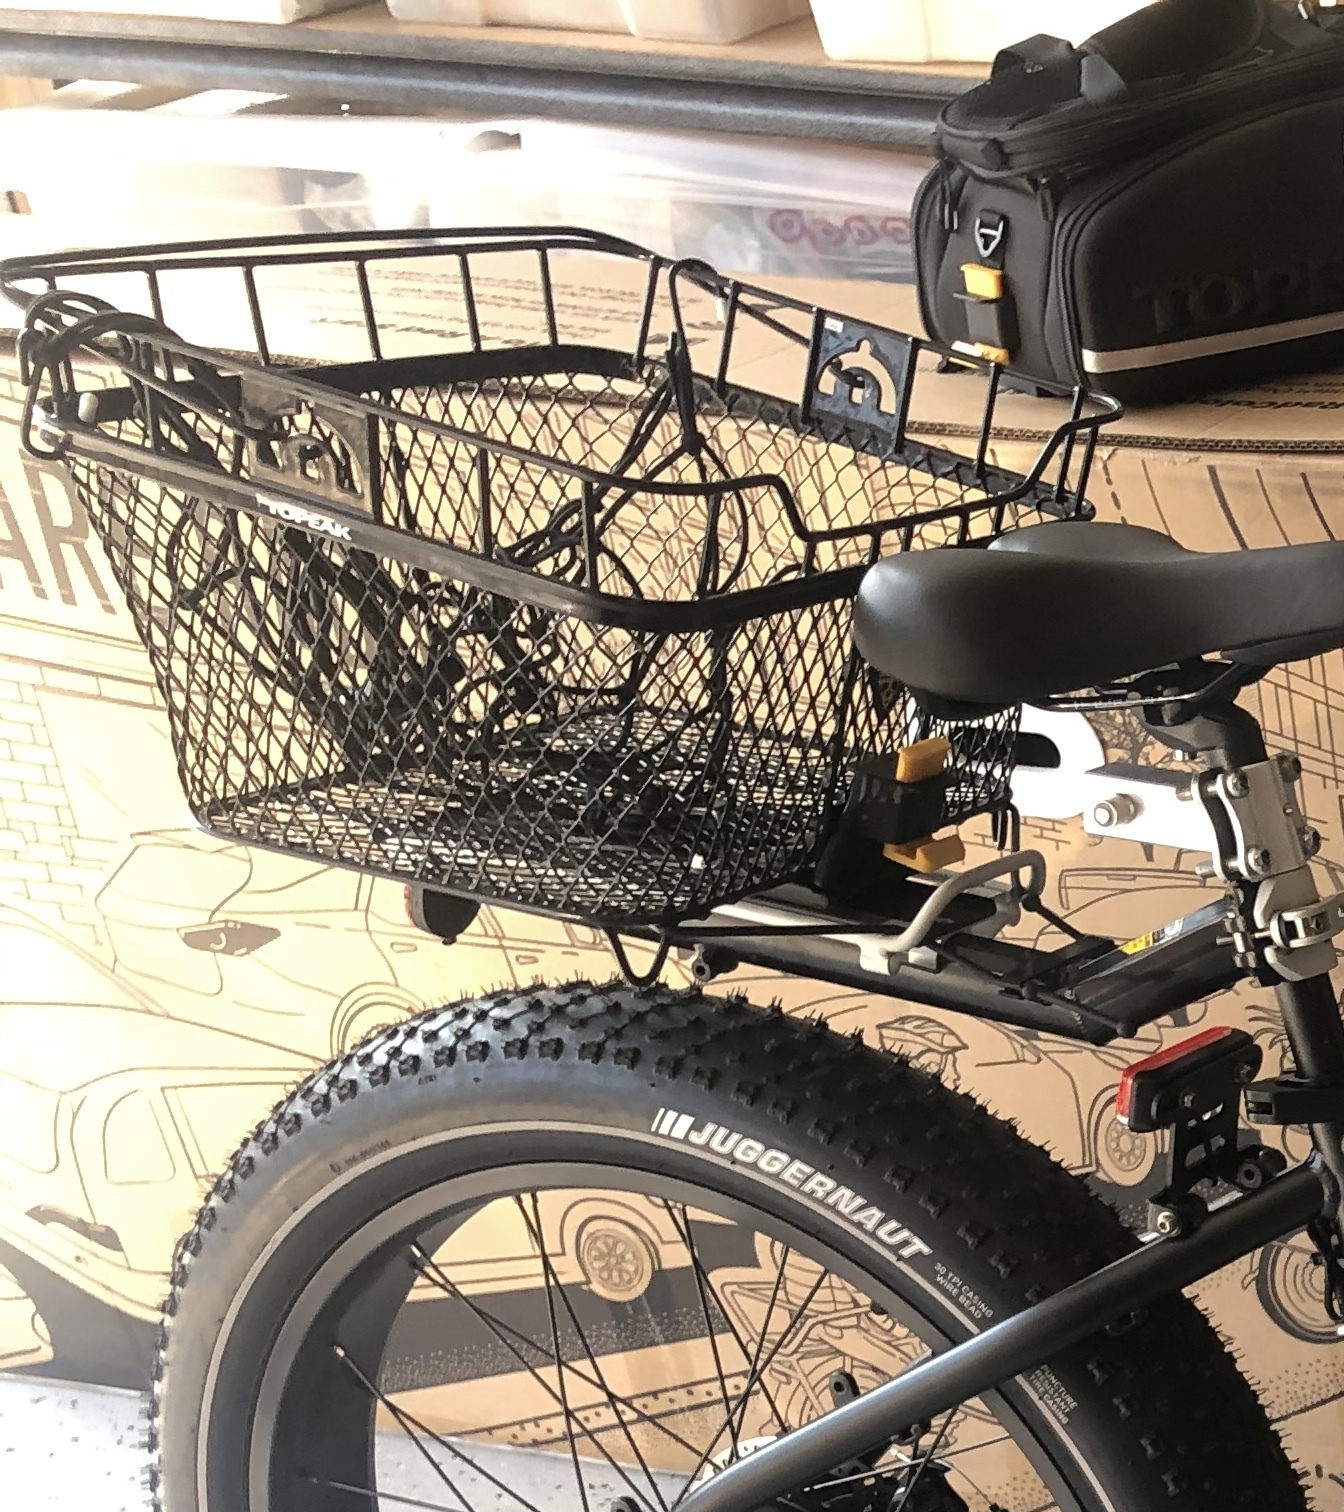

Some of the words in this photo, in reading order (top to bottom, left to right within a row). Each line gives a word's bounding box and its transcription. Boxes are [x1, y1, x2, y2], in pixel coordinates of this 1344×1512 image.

[256, 493, 353, 541] TOPEAK
[688, 1121, 933, 1259] JUGGERNAUT
[934, 1262, 947, 1275] 30
[947, 1271, 963, 1287] TPI
[961, 1282, 994, 1318] CASING
[936, 1274, 960, 1297] WIRE
[958, 1295, 982, 1319] BEAD
[1029, 1375, 1046, 1394] TIRE
[1043, 1392, 1069, 1425] CASING
[1034, 1369, 1072, 1414] RESISTANT
[1040, 1363, 1078, 1409] PUNCTURE
